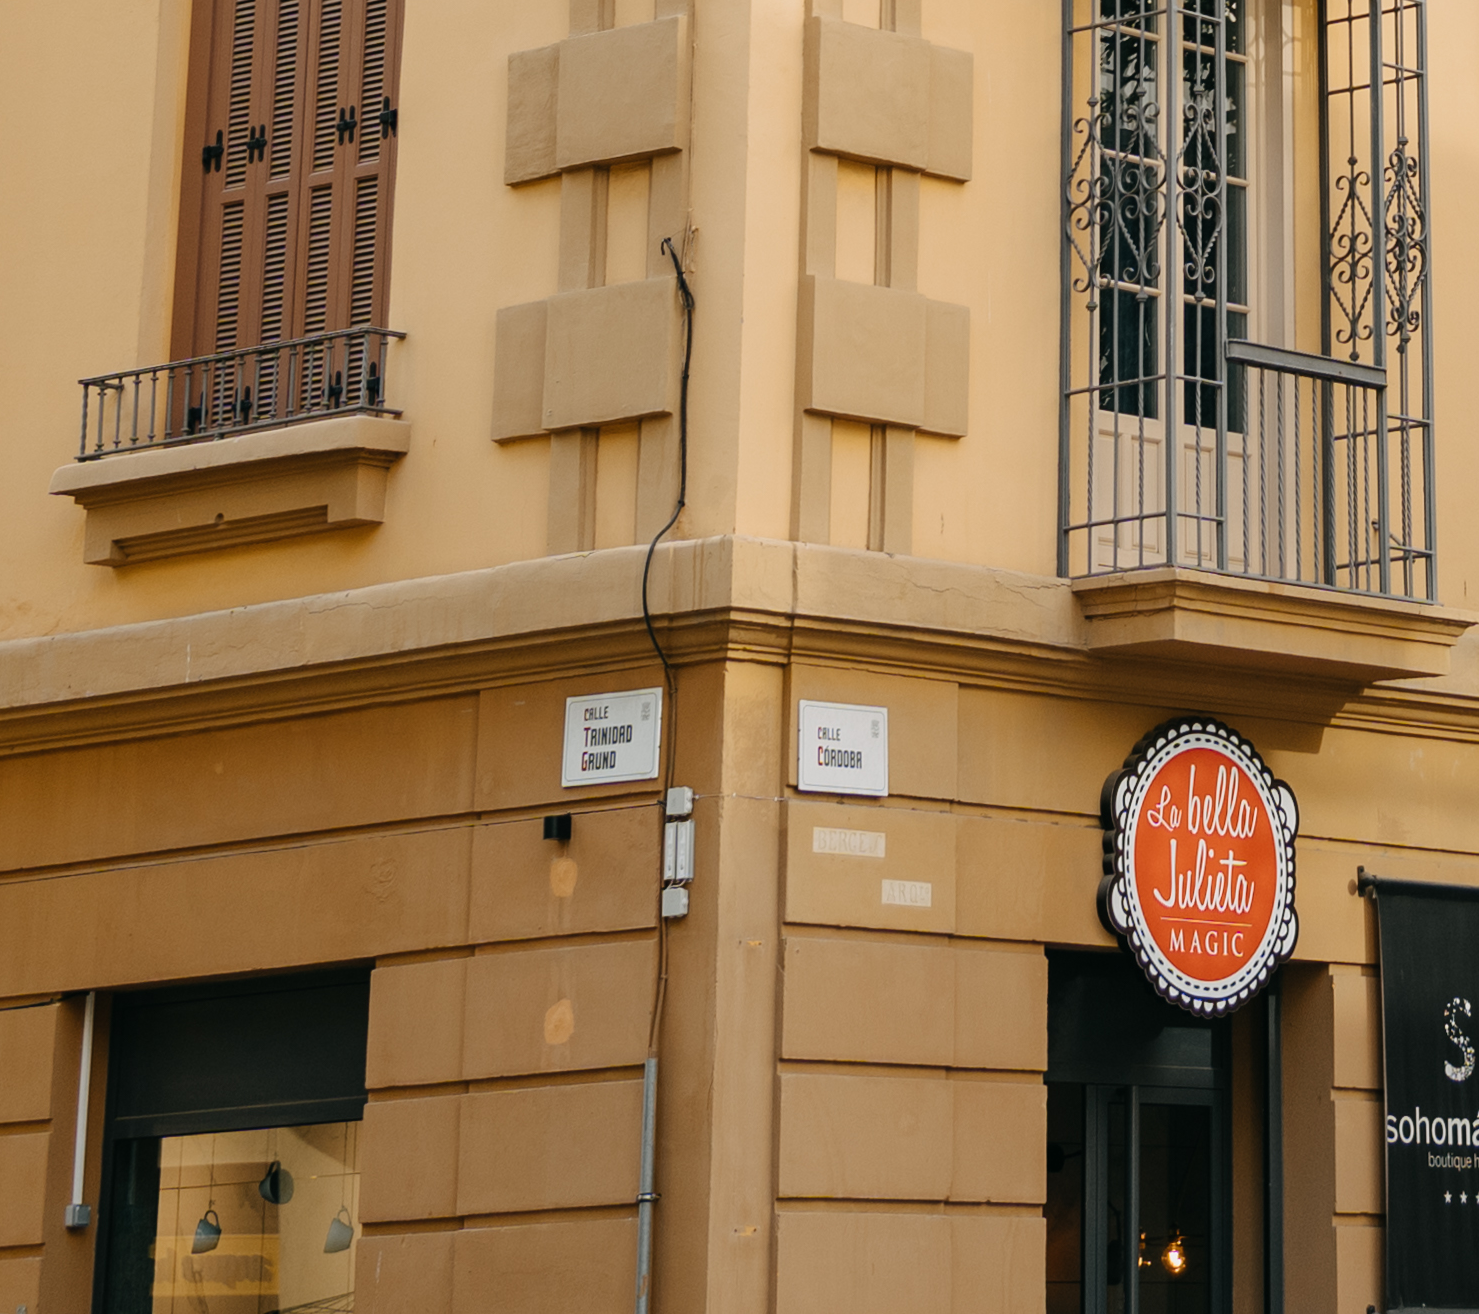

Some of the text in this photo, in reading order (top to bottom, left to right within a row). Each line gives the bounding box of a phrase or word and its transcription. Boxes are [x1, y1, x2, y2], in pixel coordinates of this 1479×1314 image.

[584, 705, 609, 721] CALLE
[583, 724, 633, 747] TRINIDAD
[817, 726, 841, 741] CALLE
[581, 750, 616, 772] GRUND
[817, 745, 862, 769] CÓRDOBA
[1147, 764, 1258, 839] La bella
[1153, 838, 1255, 914] Julieta
[1169, 928, 1244, 958] MAGIC
[1427, 1151, 1472, 1172] boutique
